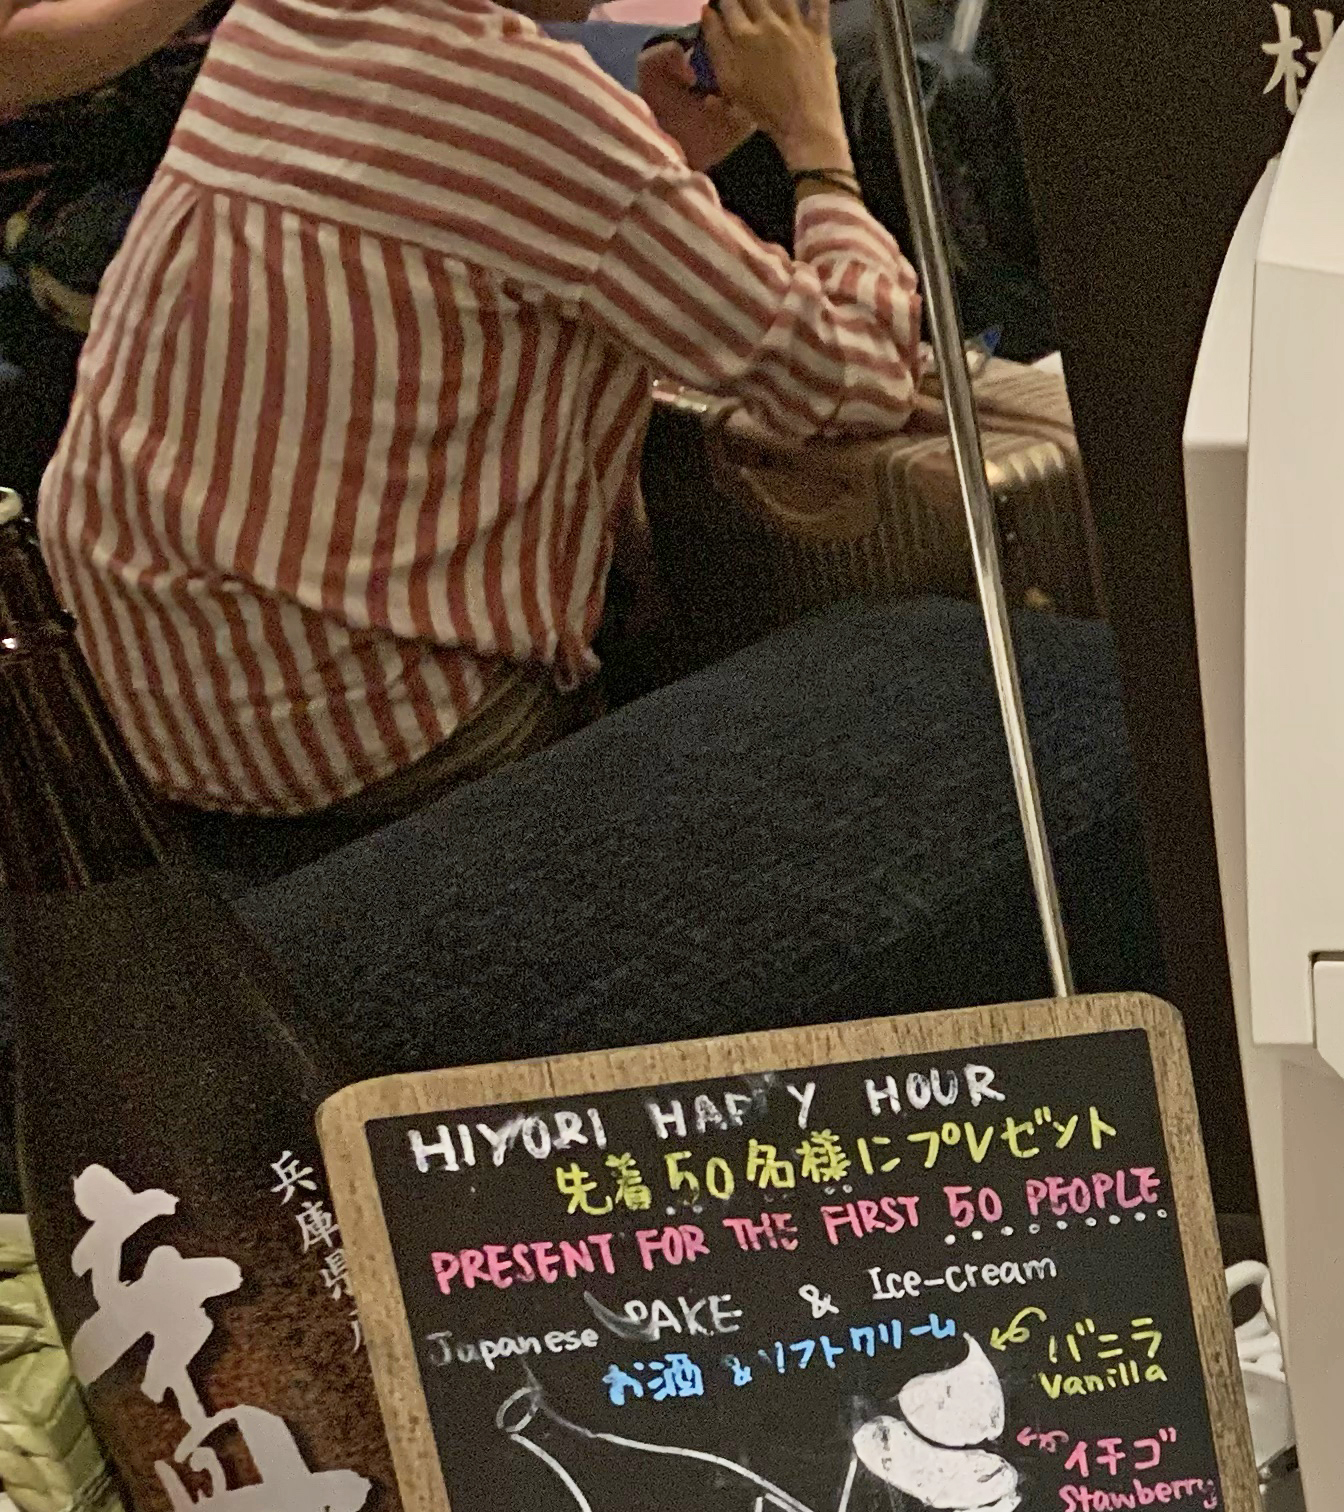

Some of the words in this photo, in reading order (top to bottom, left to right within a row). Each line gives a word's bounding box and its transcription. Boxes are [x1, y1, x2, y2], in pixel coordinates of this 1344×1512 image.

[407, 1107, 607, 1173] HIYORI
[864, 1063, 1006, 1116] HOUR
[270, 1150, 361, 1352] 兵庫県
[431, 1233, 616, 1295] PRESENT
[635, 1225, 710, 1271] FOR
[723, 1213, 798, 1251] THE
[820, 1196, 920, 1245] FIRST
[944, 1185, 1003, 1228] 50
[1026, 1167, 1161, 1216] PEOPLE
[426, 1326, 600, 1370] Japanese
[799, 1284, 839, 1319] &
[867, 1256, 1058, 1302] Ice-cream
[1049, 1317, 1162, 1363] バニラ
[1064, 1427, 1177, 1477] イチゴ
